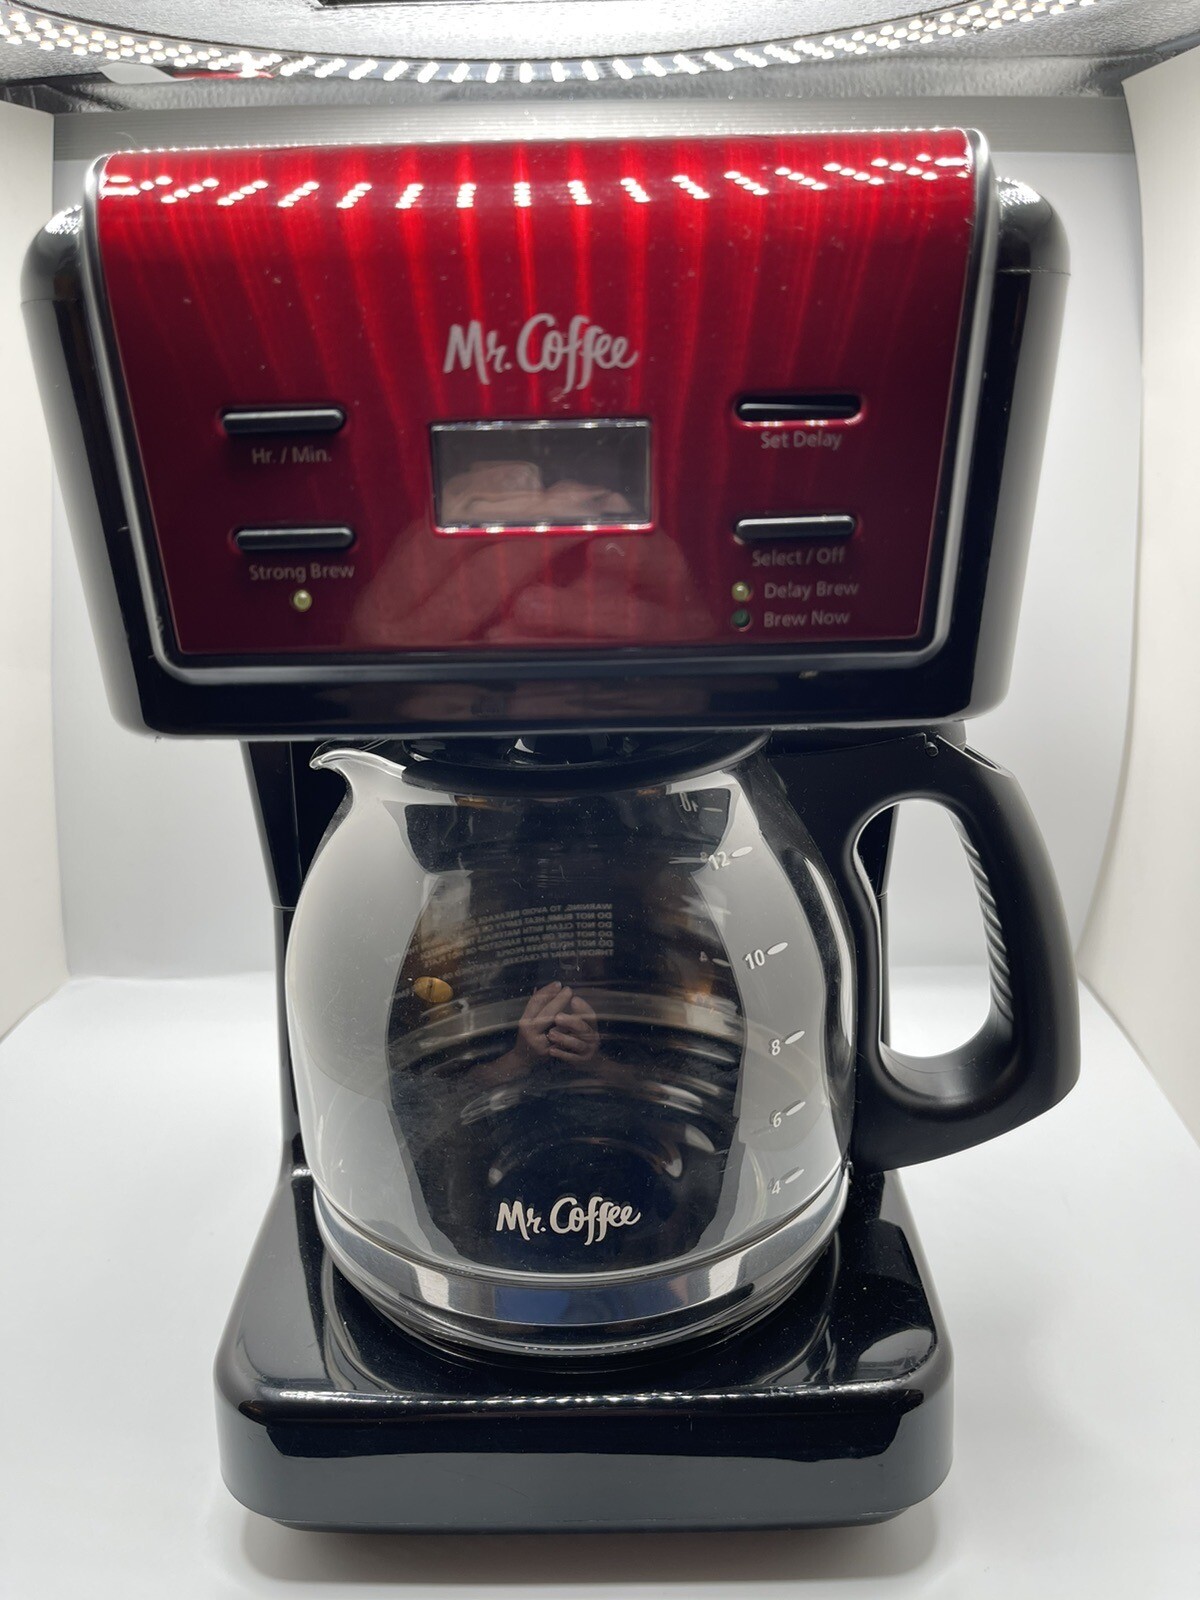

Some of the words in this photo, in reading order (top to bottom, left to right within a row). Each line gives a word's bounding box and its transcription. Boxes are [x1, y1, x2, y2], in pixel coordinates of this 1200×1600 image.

[443, 319, 512, 386] Mr.
[515, 312, 640, 394] Coffee
[760, 431, 789, 449] Set
[793, 430, 842, 450] Delay
[251, 448, 276, 465] Hr.
[291, 446, 333, 463] Min.
[752, 551, 801, 567] Select
[816, 546, 846, 564] Off
[249, 564, 307, 583] Strong
[310, 563, 355, 580] Brew
[764, 582, 812, 601] Delay
[816, 580, 859, 597] Brew
[763, 611, 808, 628] Brew
[811, 610, 850, 626] Now
[708, 851, 731, 871] 12
[745, 949, 766, 970] 10
[771, 1039, 781, 1056] 8
[772, 1112, 782, 1128] 6
[771, 1180, 782, 1195] 4
[496, 1201, 547, 1241] Mr.
[550, 1196, 641, 1246] Coffee
